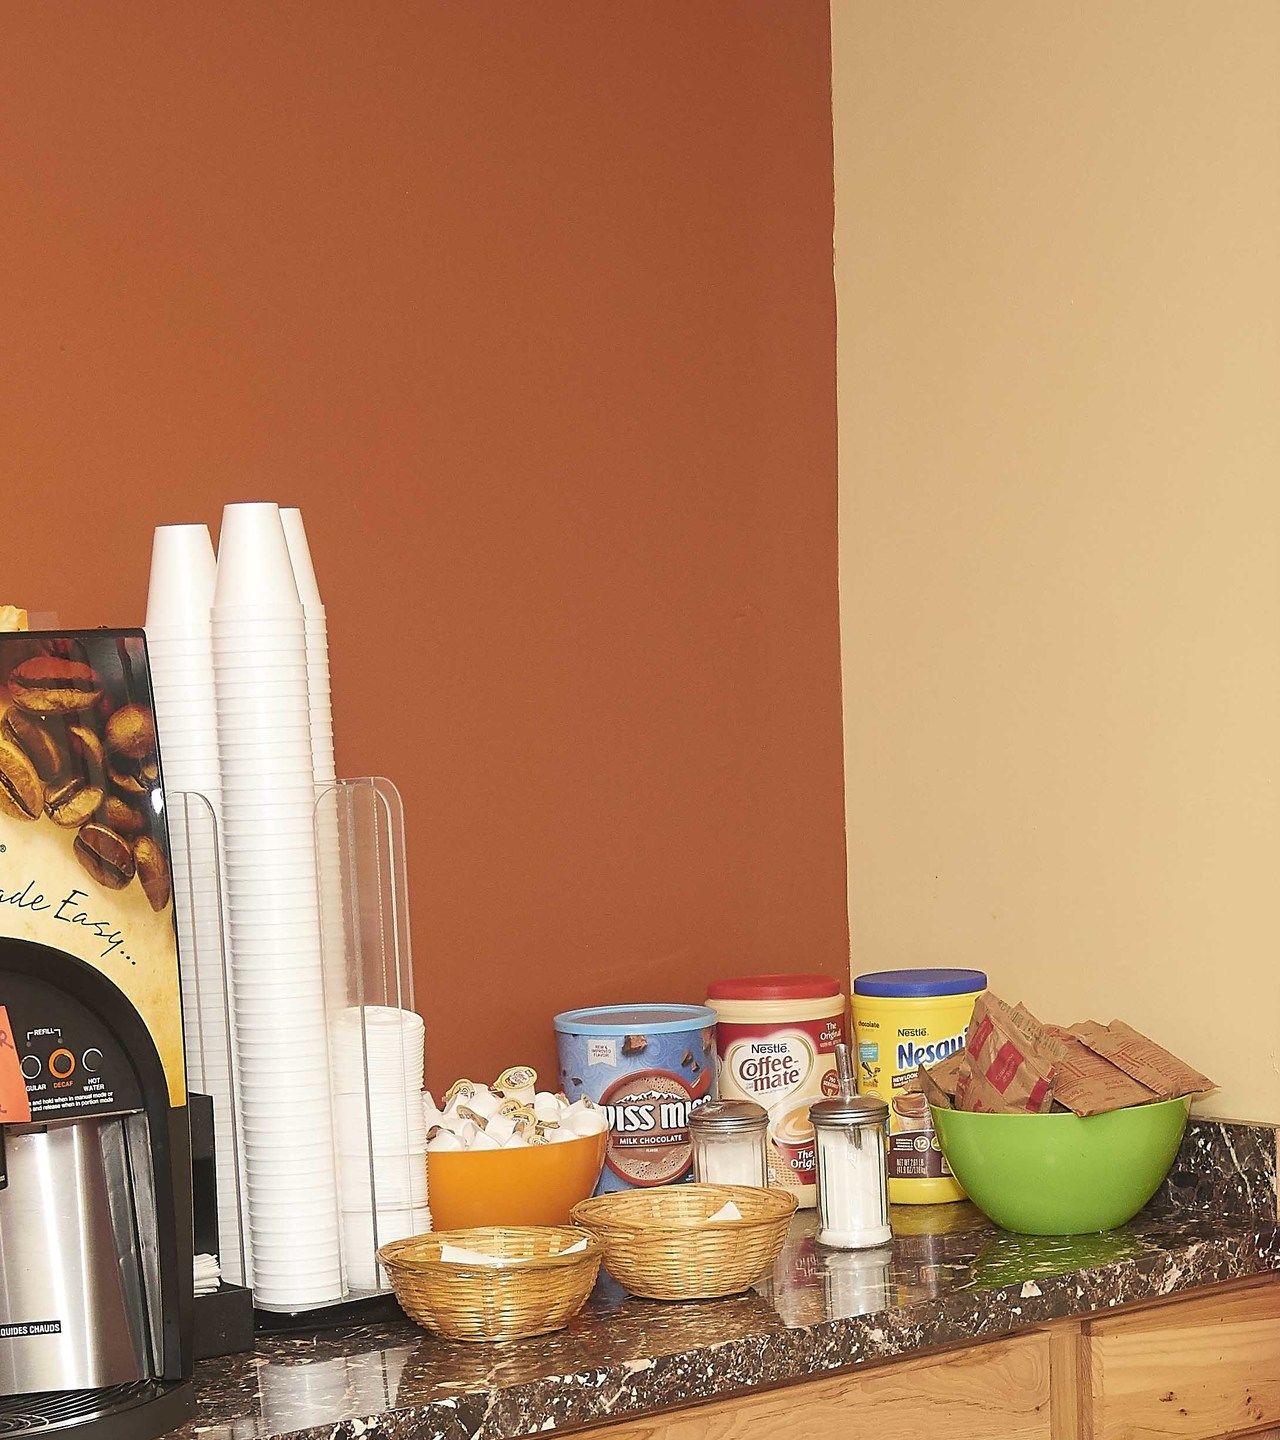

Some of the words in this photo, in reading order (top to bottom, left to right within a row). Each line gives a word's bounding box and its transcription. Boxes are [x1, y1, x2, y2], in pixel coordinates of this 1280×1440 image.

[34, 1028, 55, 1036] REFILL
[739, 1055, 799, 1081] Coffee-
[53, 1080, 74, 1089] DECAF
[753, 1069, 800, 1092] mate
[25, 1083, 47, 1092] GULAR
[83, 1084, 105, 1092] WATER
[81, 1098, 99, 1107] portion
[639, 1134, 682, 1145] CHOCOLATE
[916, 1140, 927, 1149] 12
[798, 1150, 813, 1160] The
[790, 1156, 815, 1170] Origi
[29, 1323, 60, 1334] CHAUDS
